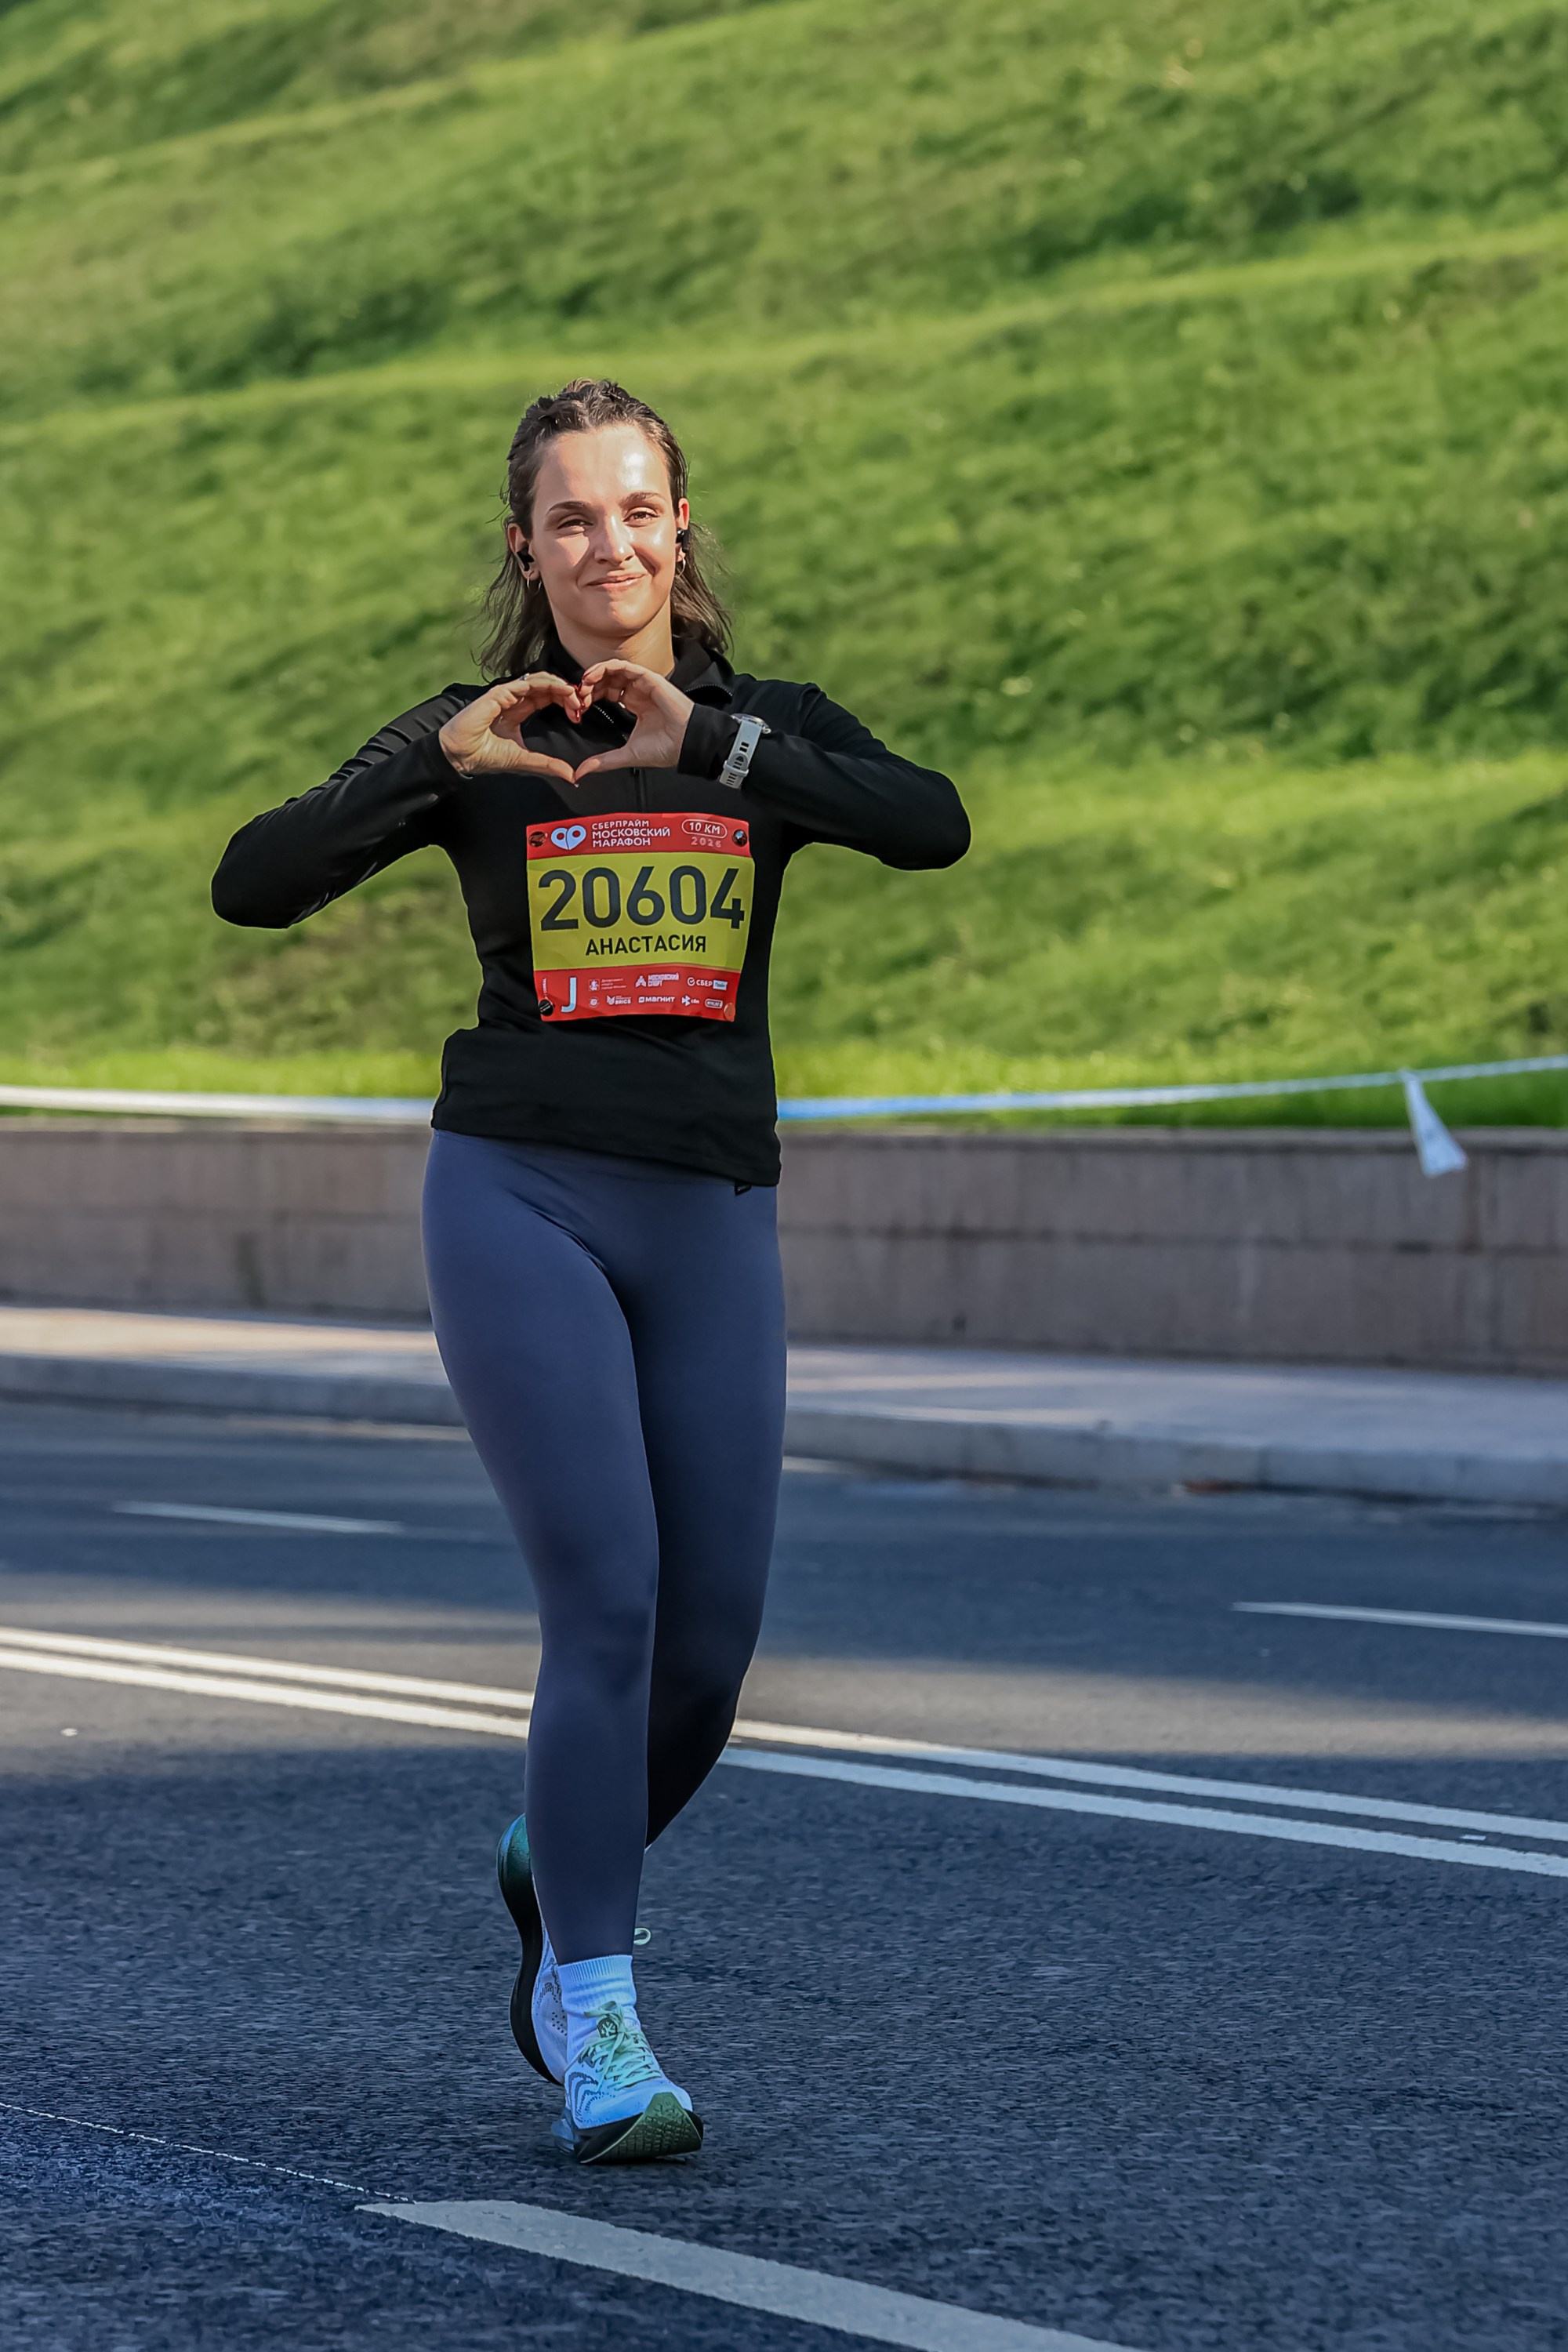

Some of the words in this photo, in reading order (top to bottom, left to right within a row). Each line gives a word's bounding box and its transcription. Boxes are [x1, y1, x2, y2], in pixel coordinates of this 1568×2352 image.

[592, 819, 650, 830] СБЕРПРАЙМ
[689, 822, 702, 832] 10
[592, 827, 671, 840] МОСКОВСКИЙ
[593, 837, 651, 848] МАРАФОН
[691, 837, 721, 848] 2026
[538, 865, 745, 931] 20604
[585, 934, 706, 956] АНАСТАСИЯ
[561, 977, 577, 1013] J
